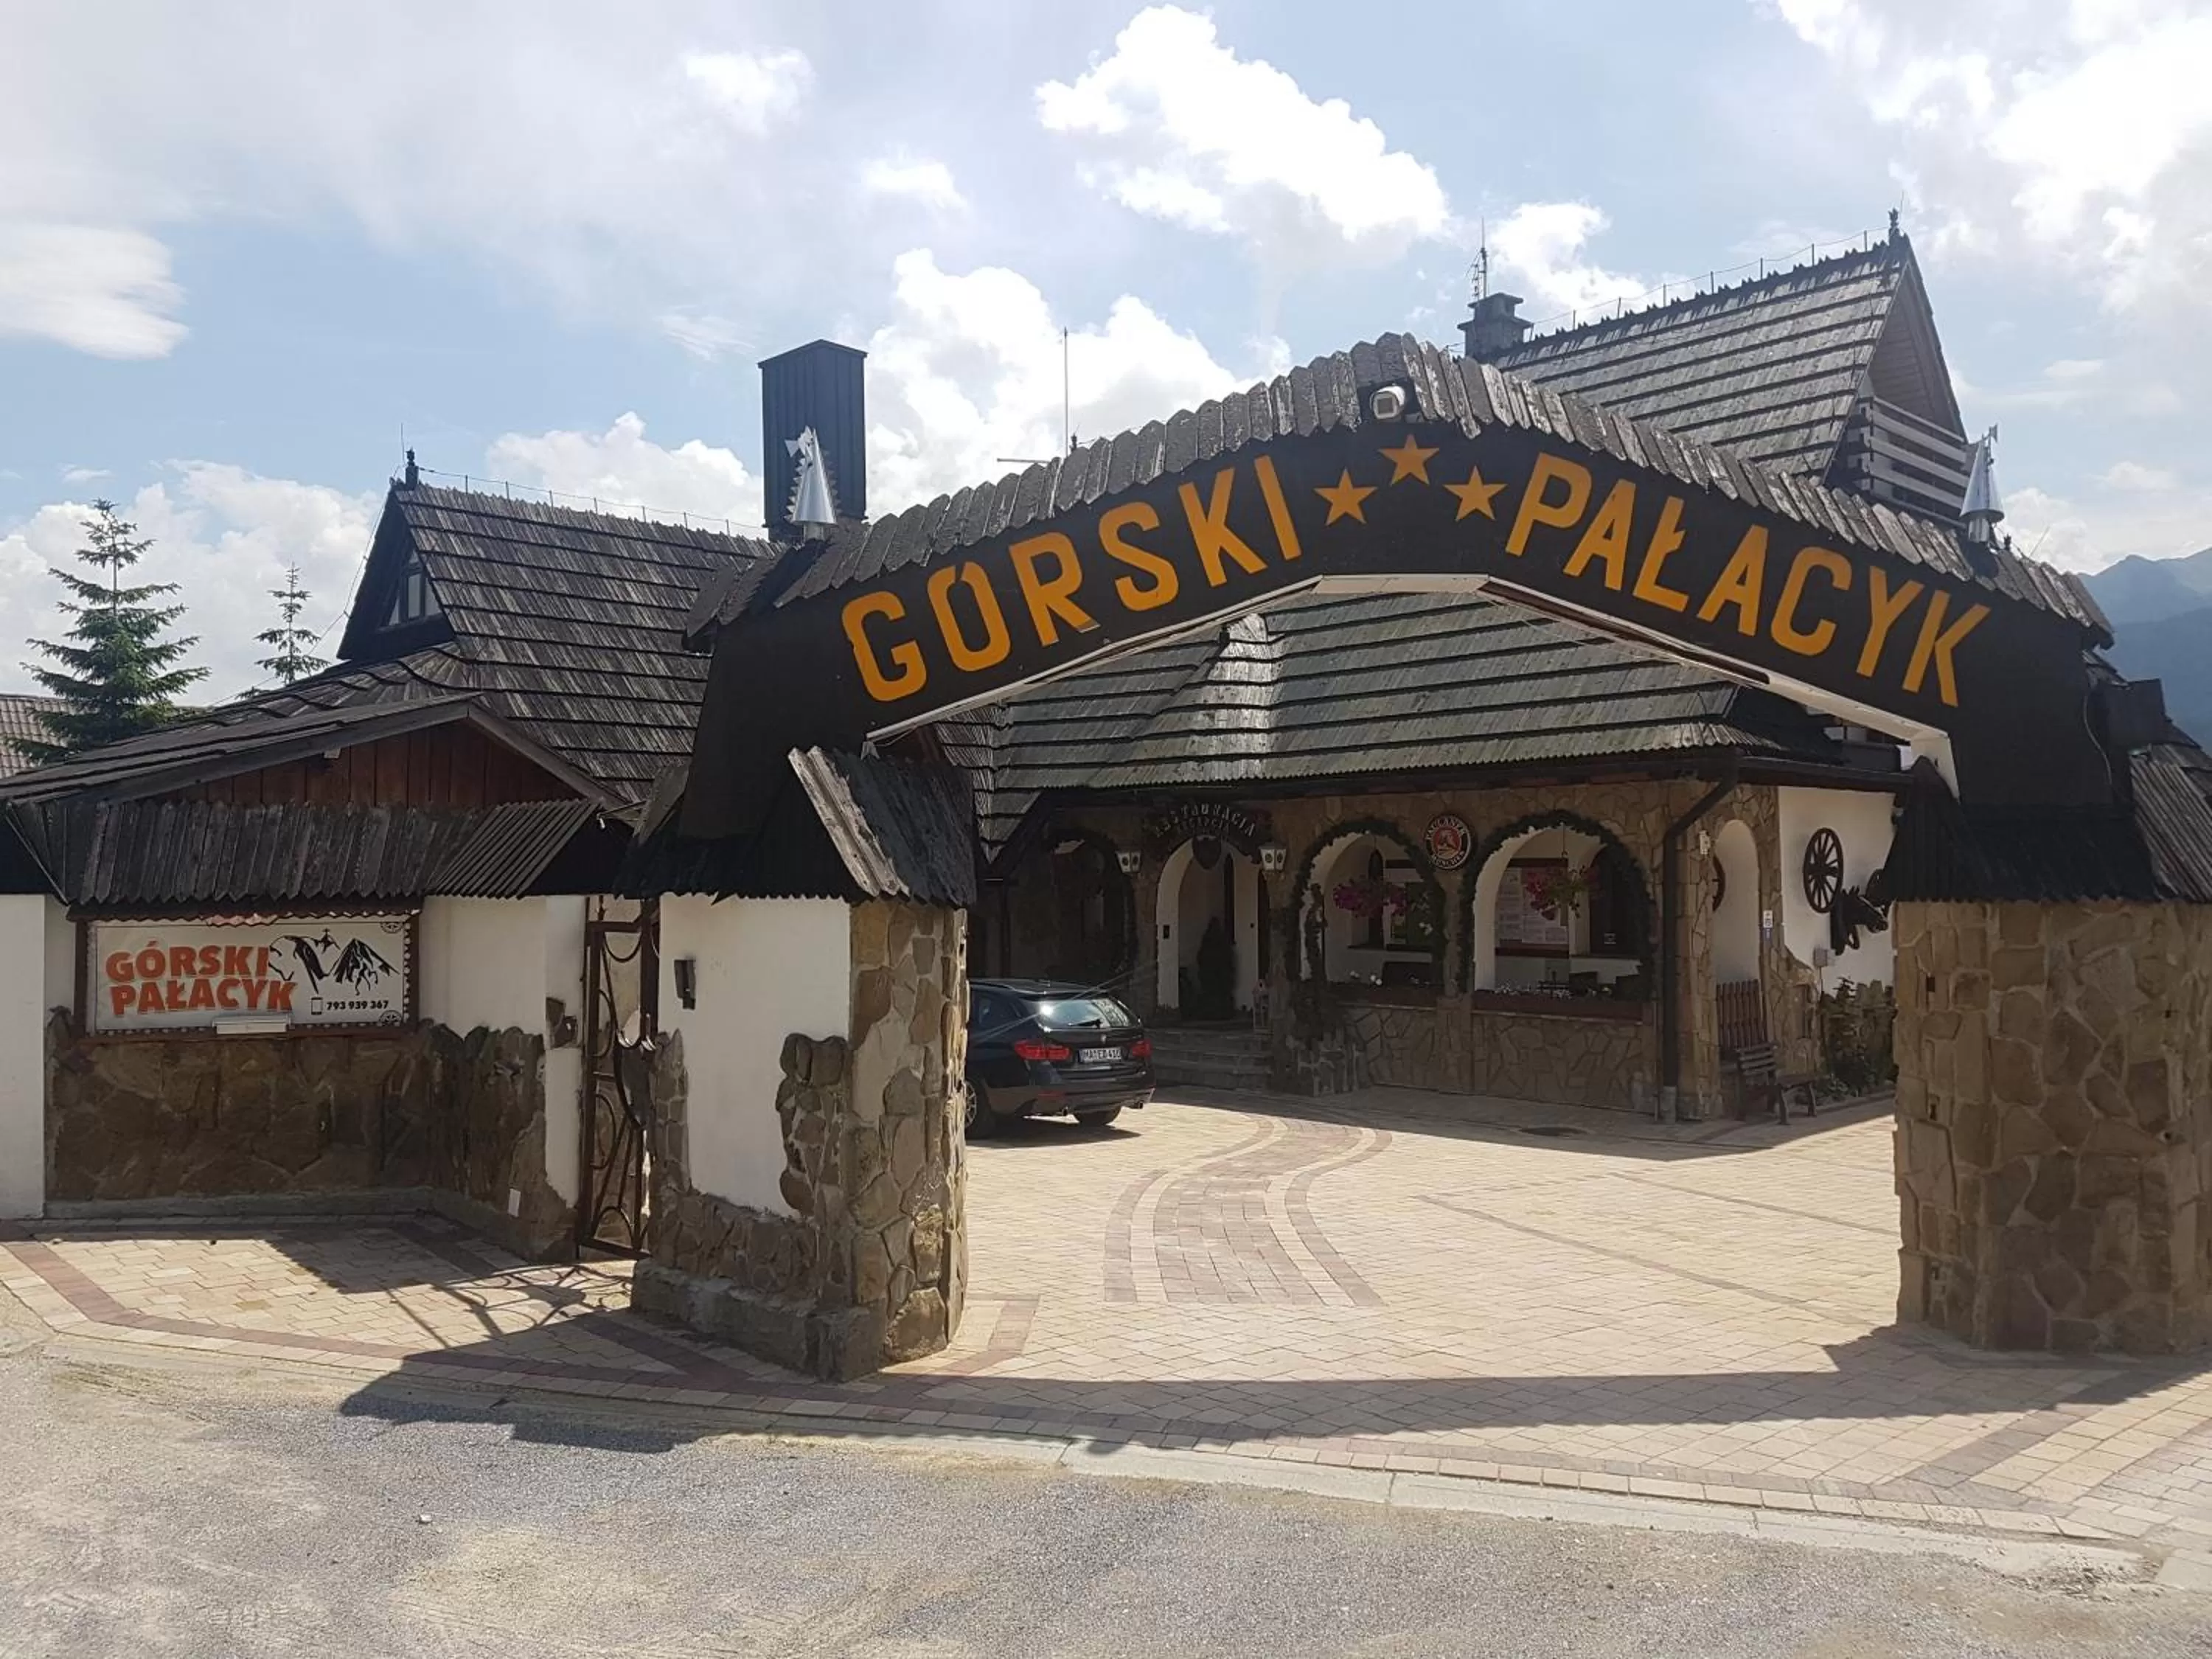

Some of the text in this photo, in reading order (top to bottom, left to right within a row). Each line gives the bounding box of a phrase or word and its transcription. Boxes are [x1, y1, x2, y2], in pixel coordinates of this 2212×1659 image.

[1506, 452, 1991, 706] PAŁACYK
[107, 941, 268, 983] GÓRSKI
[111, 978, 298, 1016] PAŁACYK
[327, 1000, 389, 1010] 793 939 367
